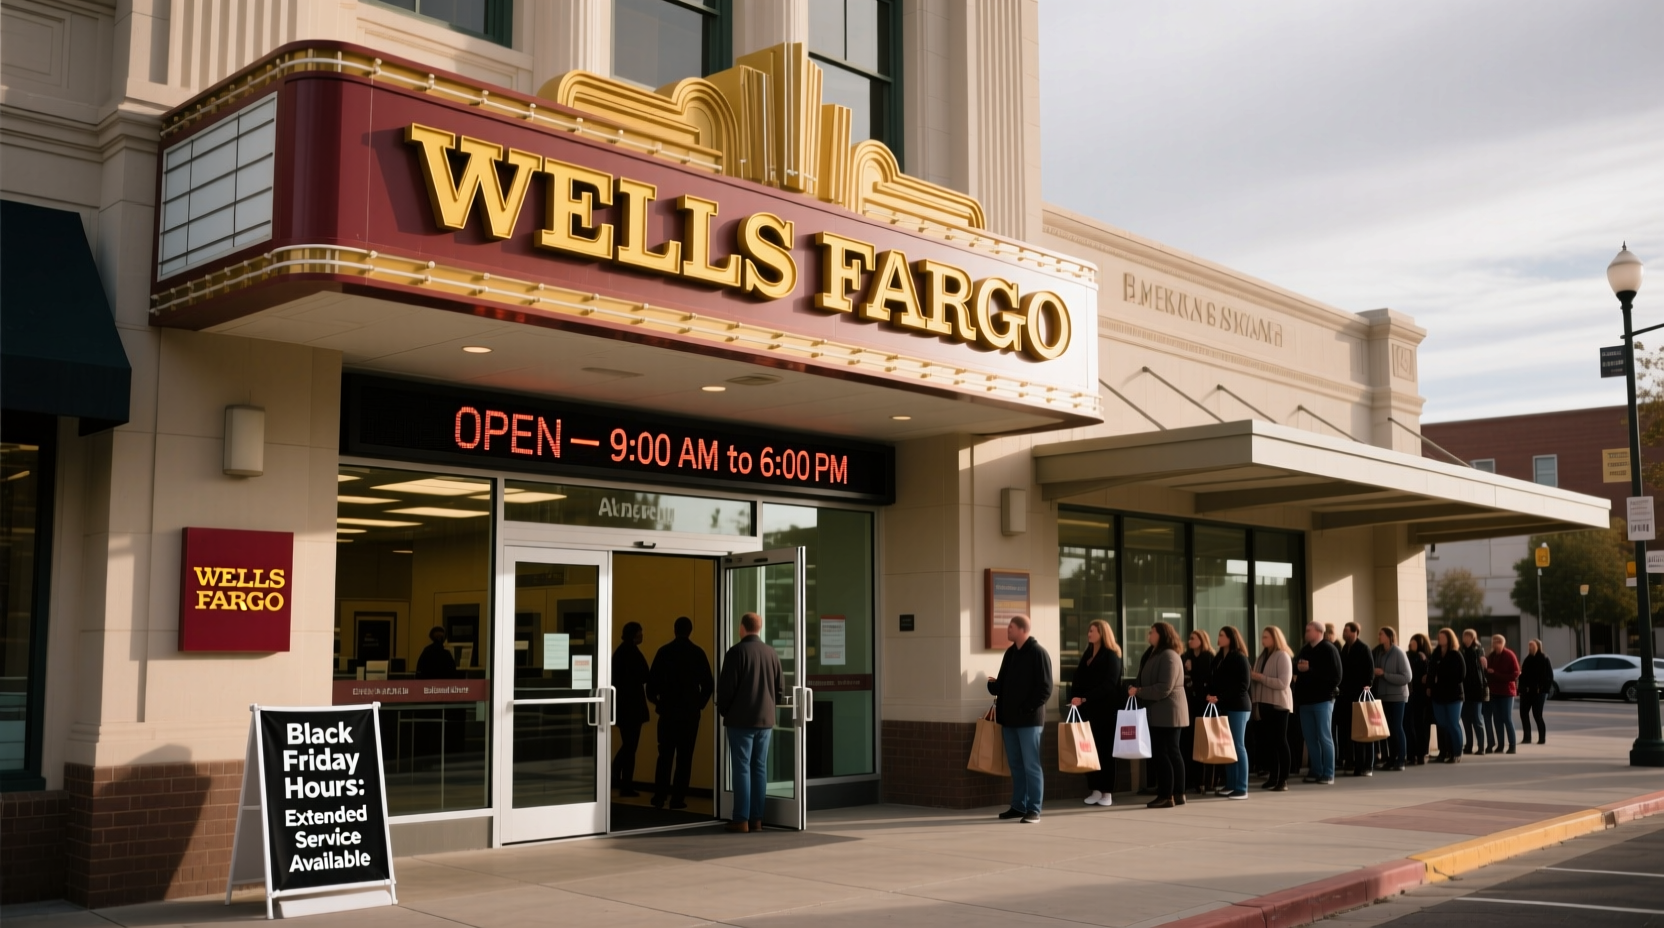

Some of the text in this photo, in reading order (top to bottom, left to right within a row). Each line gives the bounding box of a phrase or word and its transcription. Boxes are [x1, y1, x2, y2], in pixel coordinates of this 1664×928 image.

[404, 122, 797, 300] WELLS
[815, 231, 1072, 361] FARGO
[454, 406, 562, 458] OPEN
[610, 428, 670, 467] 9:00
[677, 436, 719, 472] AM
[727, 445, 753, 475] to
[760, 446, 810, 482] 6:00
[815, 452, 848, 485] PM
[193, 566, 286, 589] WELLS
[195, 590, 285, 612] FARGO
[286, 721, 354, 745] Black
[283, 747, 360, 775] Friday
[284, 776, 365, 799] Hours:
[285, 804, 368, 827] Extended
[295, 827, 362, 849] Service
[289, 850, 371, 873] Available
